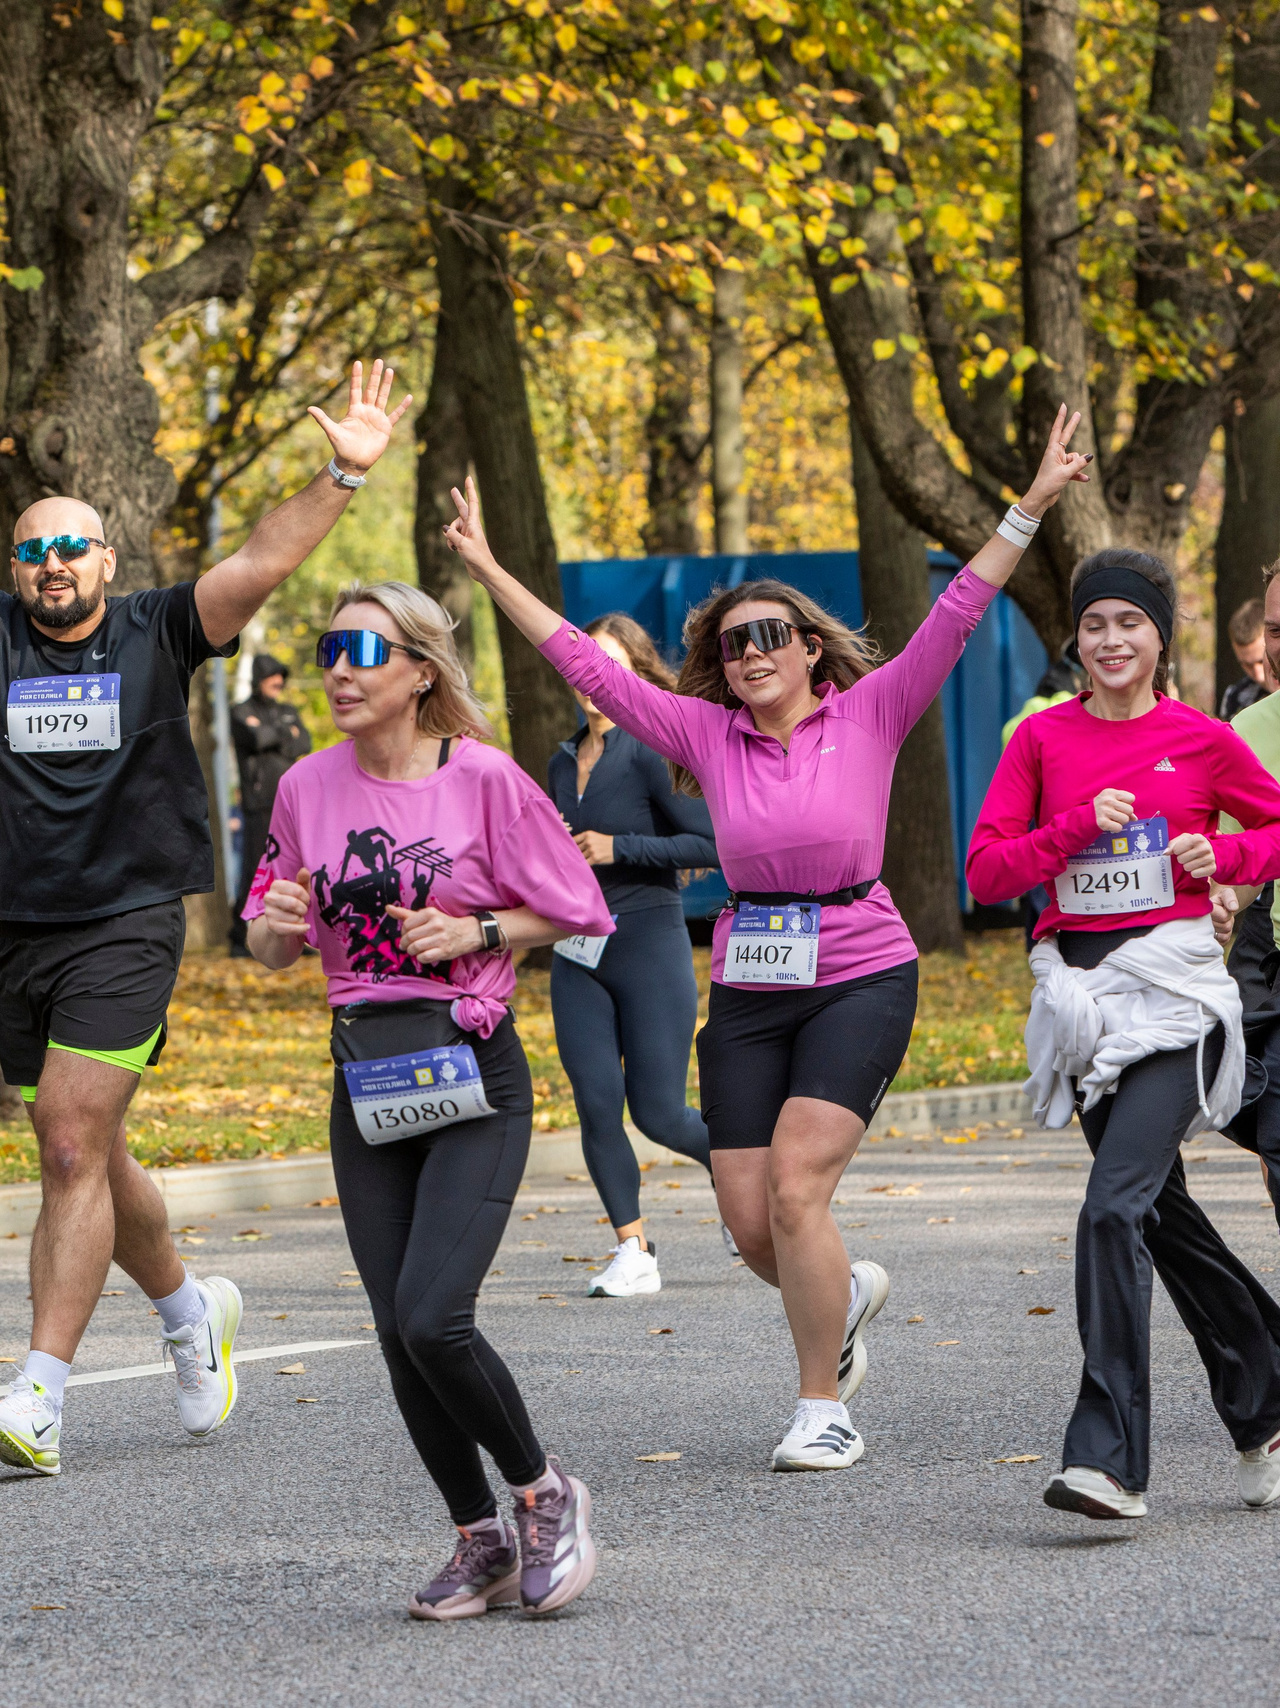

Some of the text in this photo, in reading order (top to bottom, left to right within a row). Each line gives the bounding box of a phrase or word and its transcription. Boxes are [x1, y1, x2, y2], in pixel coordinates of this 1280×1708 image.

[70, 688, 80, 696] D
[25, 714, 88, 733] 11979
[1115, 840, 1126, 851] D
[1070, 869, 1140, 893] 12491
[771, 917, 781, 927] D
[735, 945, 792, 964] 14407
[419, 1071, 431, 1083] D
[370, 1099, 460, 1130] 13080
